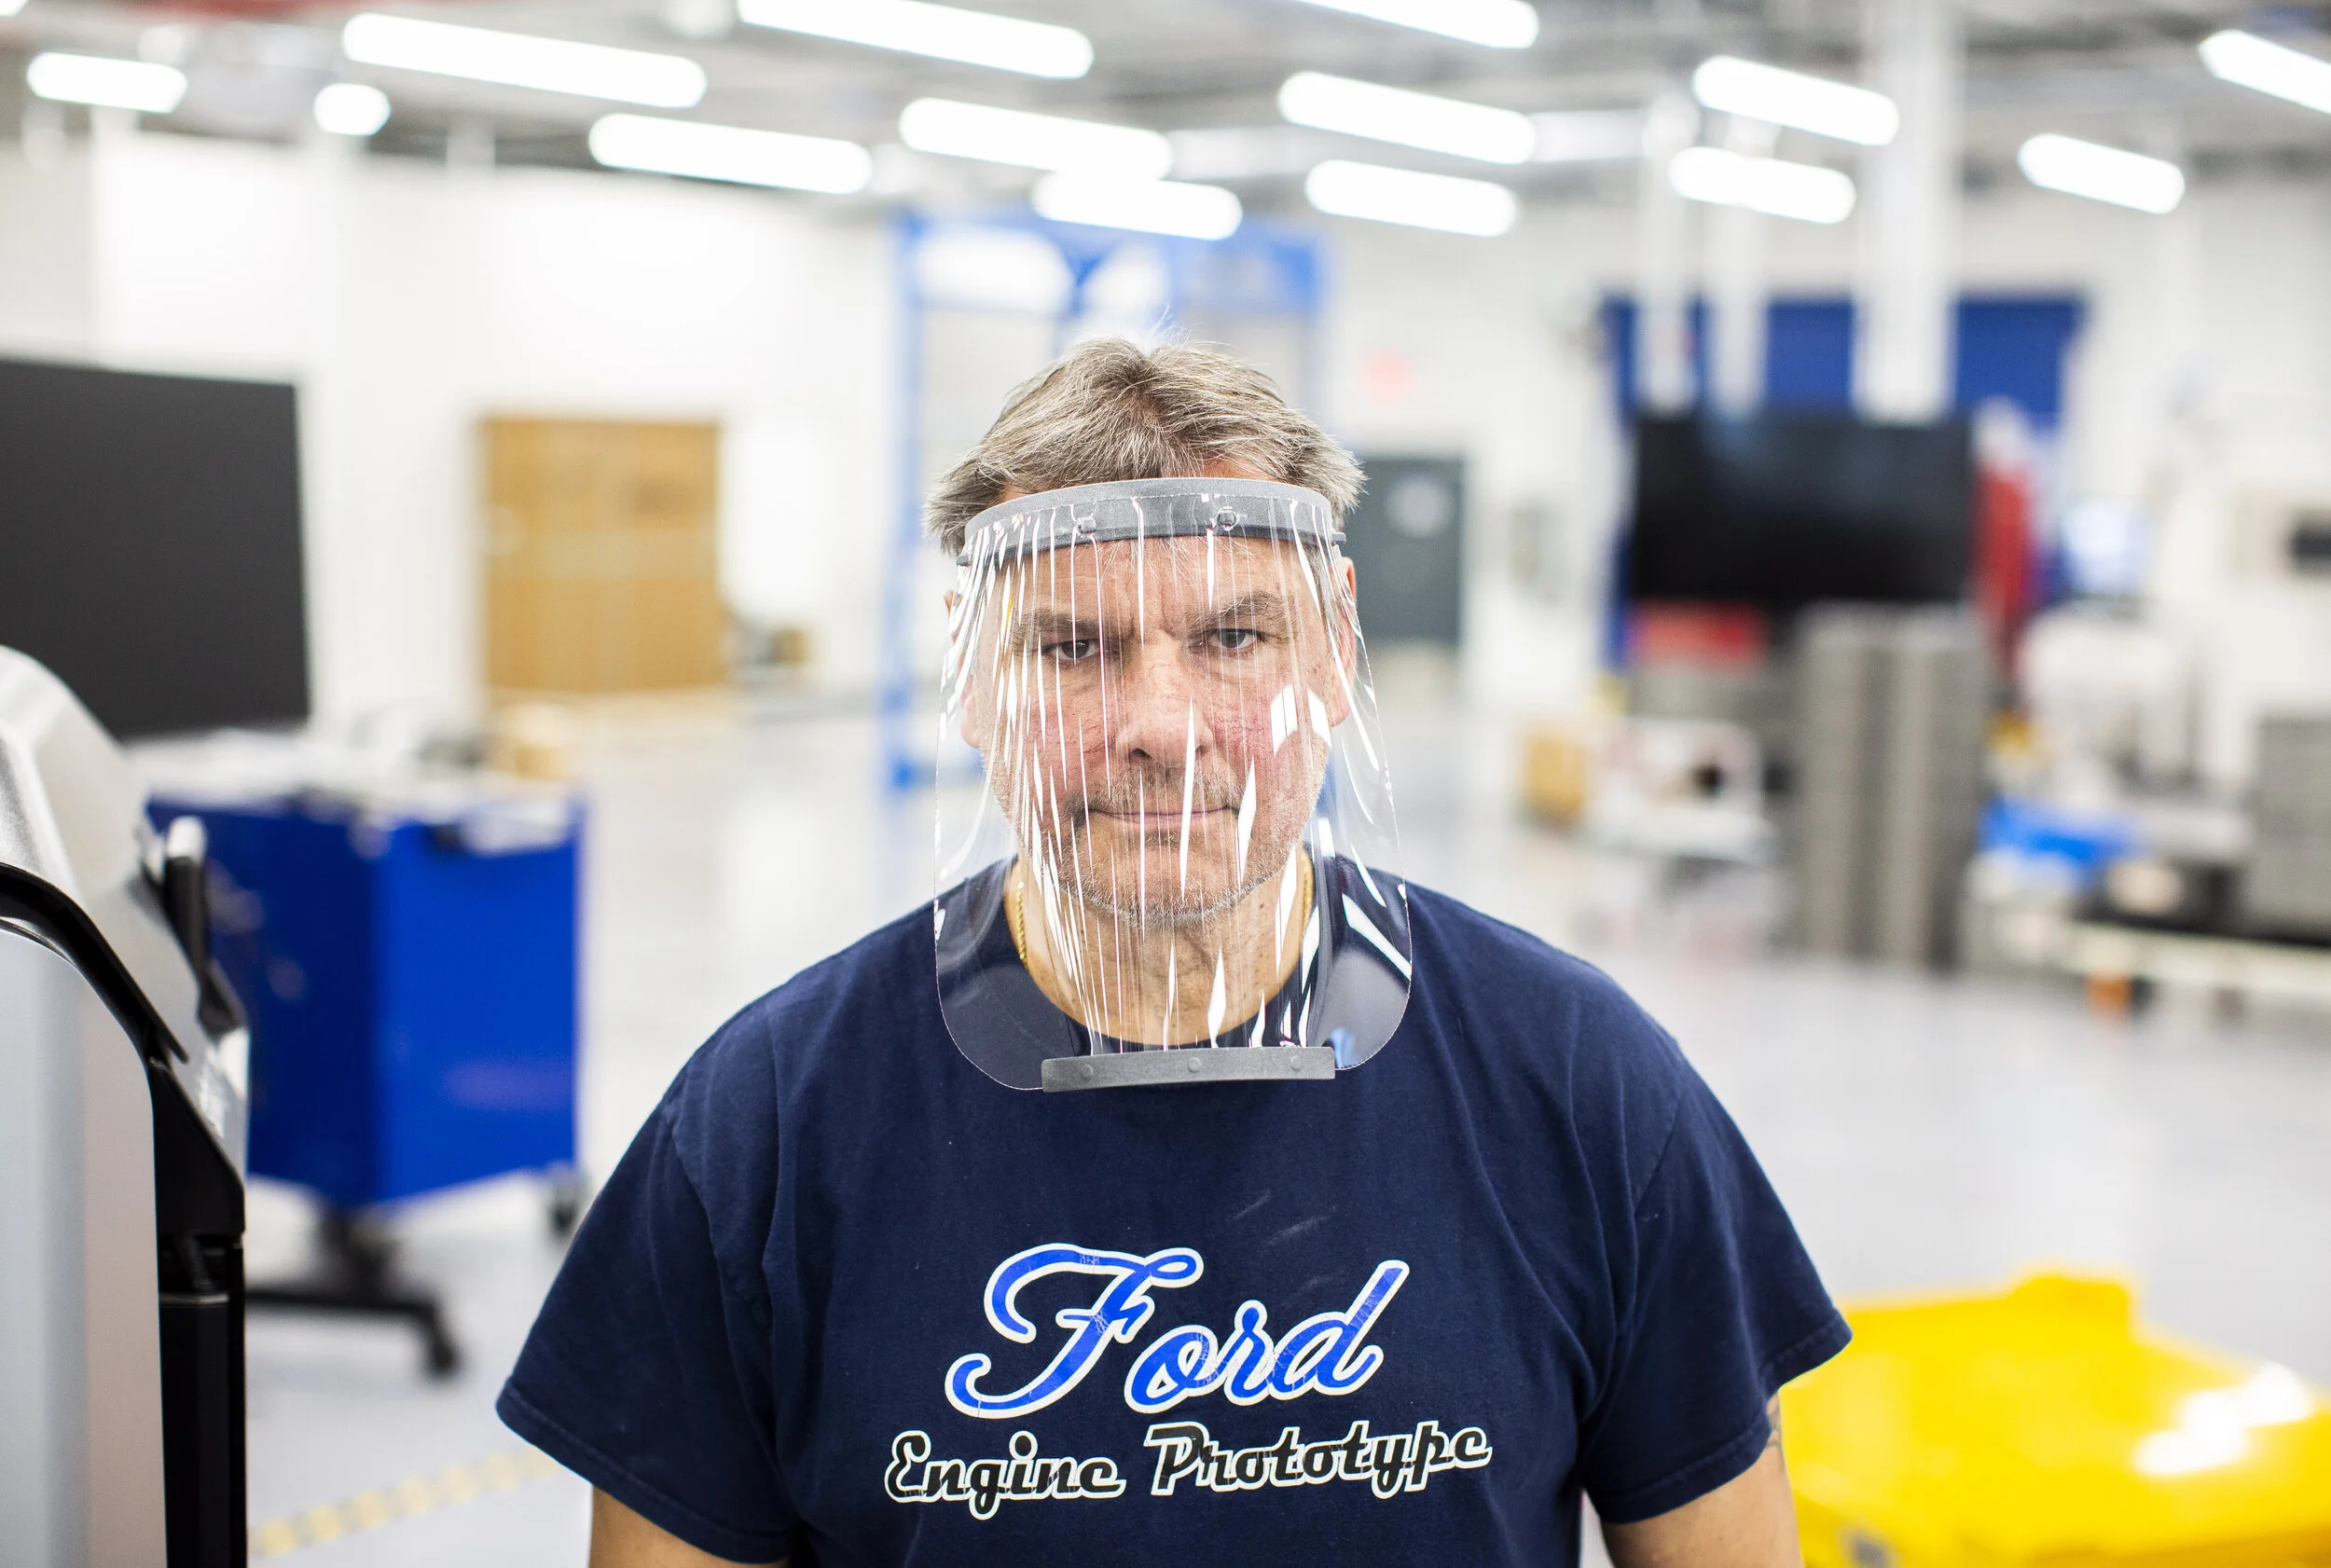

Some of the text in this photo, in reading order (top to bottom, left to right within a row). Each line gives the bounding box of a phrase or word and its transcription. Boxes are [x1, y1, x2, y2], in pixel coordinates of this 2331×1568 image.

[945, 1244, 1409, 1419] Ford
[885, 1420, 1493, 1520] Engine Prototype
